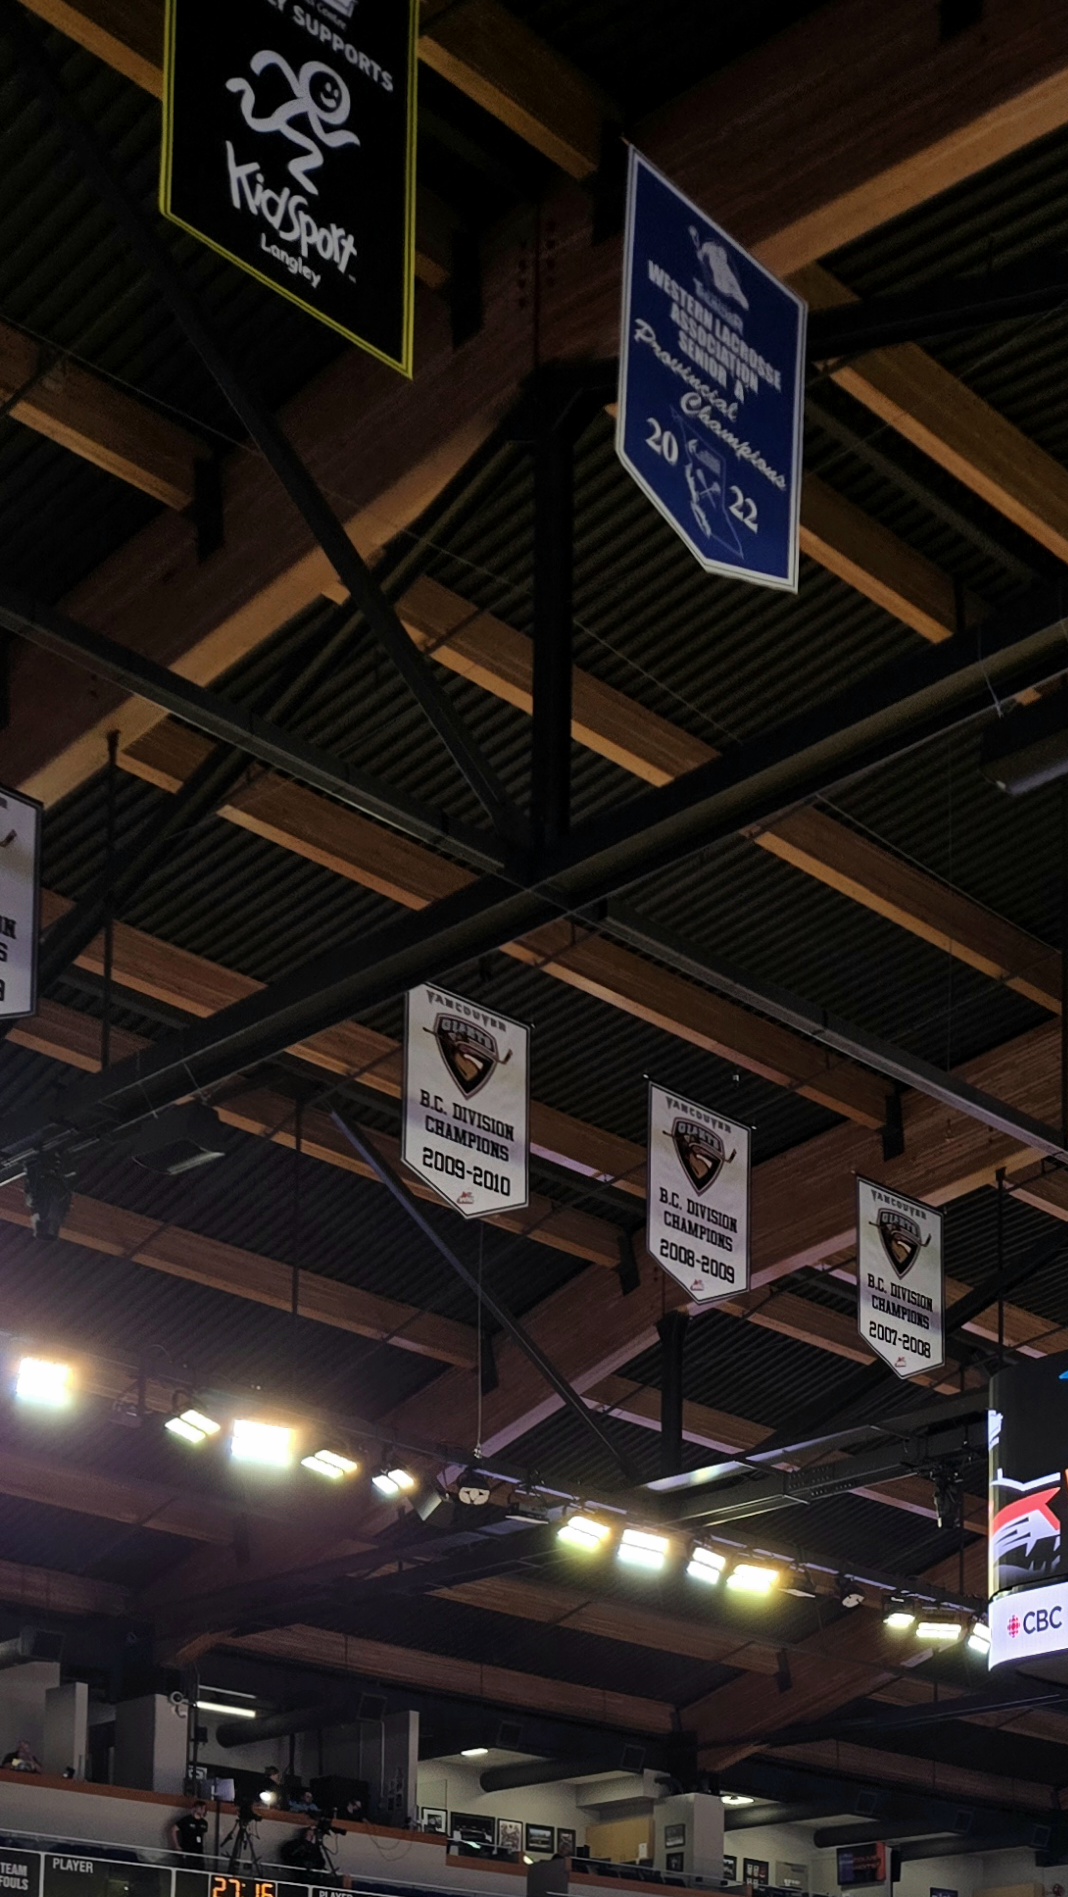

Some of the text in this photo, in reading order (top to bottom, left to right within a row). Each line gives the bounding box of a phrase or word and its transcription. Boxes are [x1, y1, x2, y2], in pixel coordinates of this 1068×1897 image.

[293, 4, 394, 92] SUPPORTS
[225, 139, 358, 274] KidSport
[260, 232, 322, 289] Langley
[648, 260, 713, 332] WESTERN
[715, 318, 781, 392] LACROSSE
[671, 302, 758, 394] ASSOCIATION
[634, 318, 738, 422] Provincial
[678, 330, 727, 390] SENIOR
[645, 418, 678, 465] 20
[681, 392, 787, 491] Champions
[729, 486, 758, 533] 22
[426, 989, 507, 1032] VANCOUVER
[420, 1089, 514, 1141] B.C. DIVISION
[665, 1096, 731, 1133] VANCOUVER
[425, 1115, 509, 1162] CHAMPIONS
[423, 1147, 510, 1196] 2009-2010
[659, 1187, 737, 1232] B.C. DIVISION
[871, 1189, 927, 1219] VANCOUVER
[663, 1210, 733, 1252] CHAMPIONS
[660, 1239, 735, 1284] 2008-2009
[867, 1273, 933, 1312] B.C. DIVISION
[872, 1295, 929, 1329] CHAMPIONS
[869, 1321, 931, 1359] 2007-2008
[1022, 1605, 1062, 1635] CBC
[0, 1862, 27, 1877] TEAM
[0, 1876, 28, 1891] FOULS
[52, 1858, 94, 1873] PLAYER
